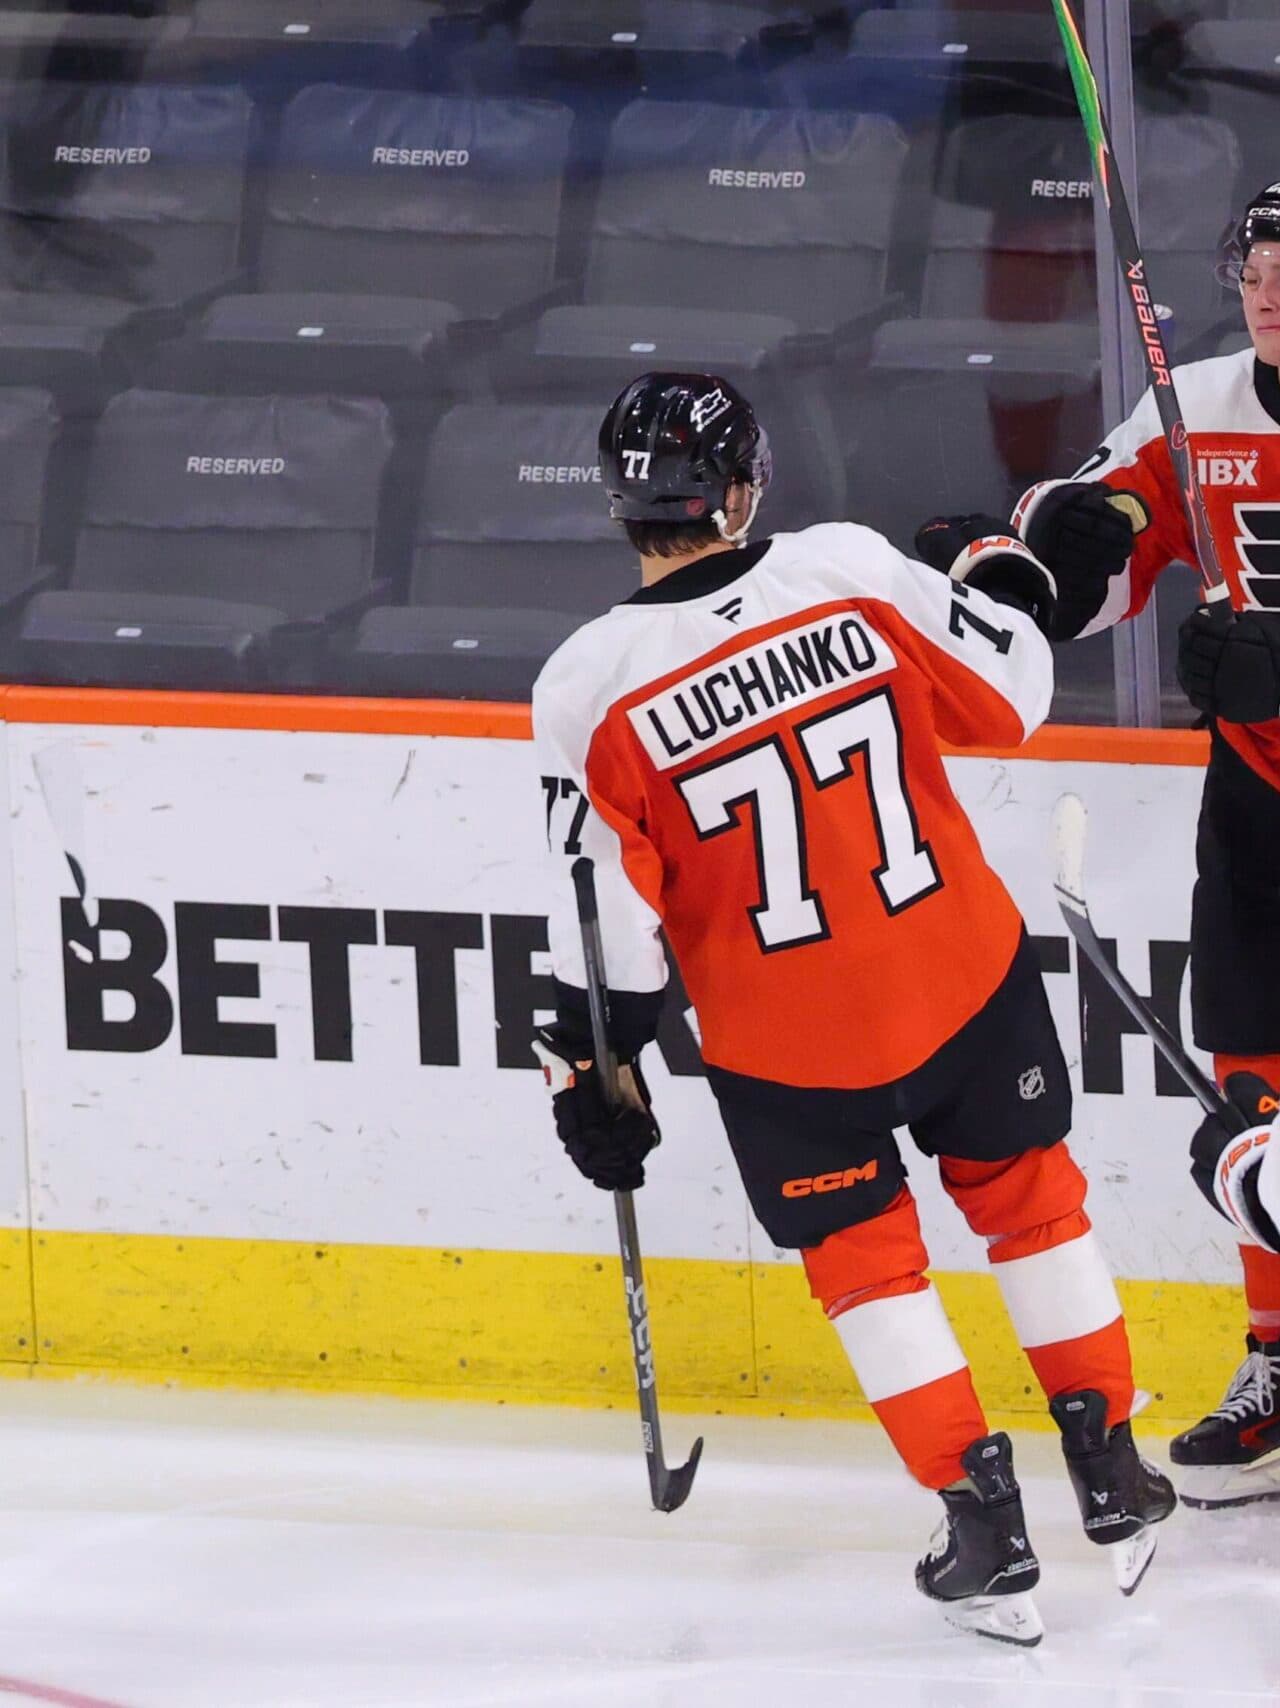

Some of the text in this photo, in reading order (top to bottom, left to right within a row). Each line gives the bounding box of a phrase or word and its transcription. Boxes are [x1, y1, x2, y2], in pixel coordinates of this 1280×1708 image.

[55, 145, 151, 165] RESERVED
[372, 147, 469, 167] RESERVED
[708, 168, 805, 189] RESERVED
[1031, 179, 1095, 199] RESER
[186, 457, 285, 475] RESERVED
[519, 465, 602, 483] RESERVE
[622, 450, 651, 480] 77
[1198, 458, 1258, 486] IBX
[647, 620, 877, 757] LUCHANKO
[673, 684, 945, 956] 77
[60, 896, 706, 1077] BETTE
[782, 1160, 878, 1199] CCM
